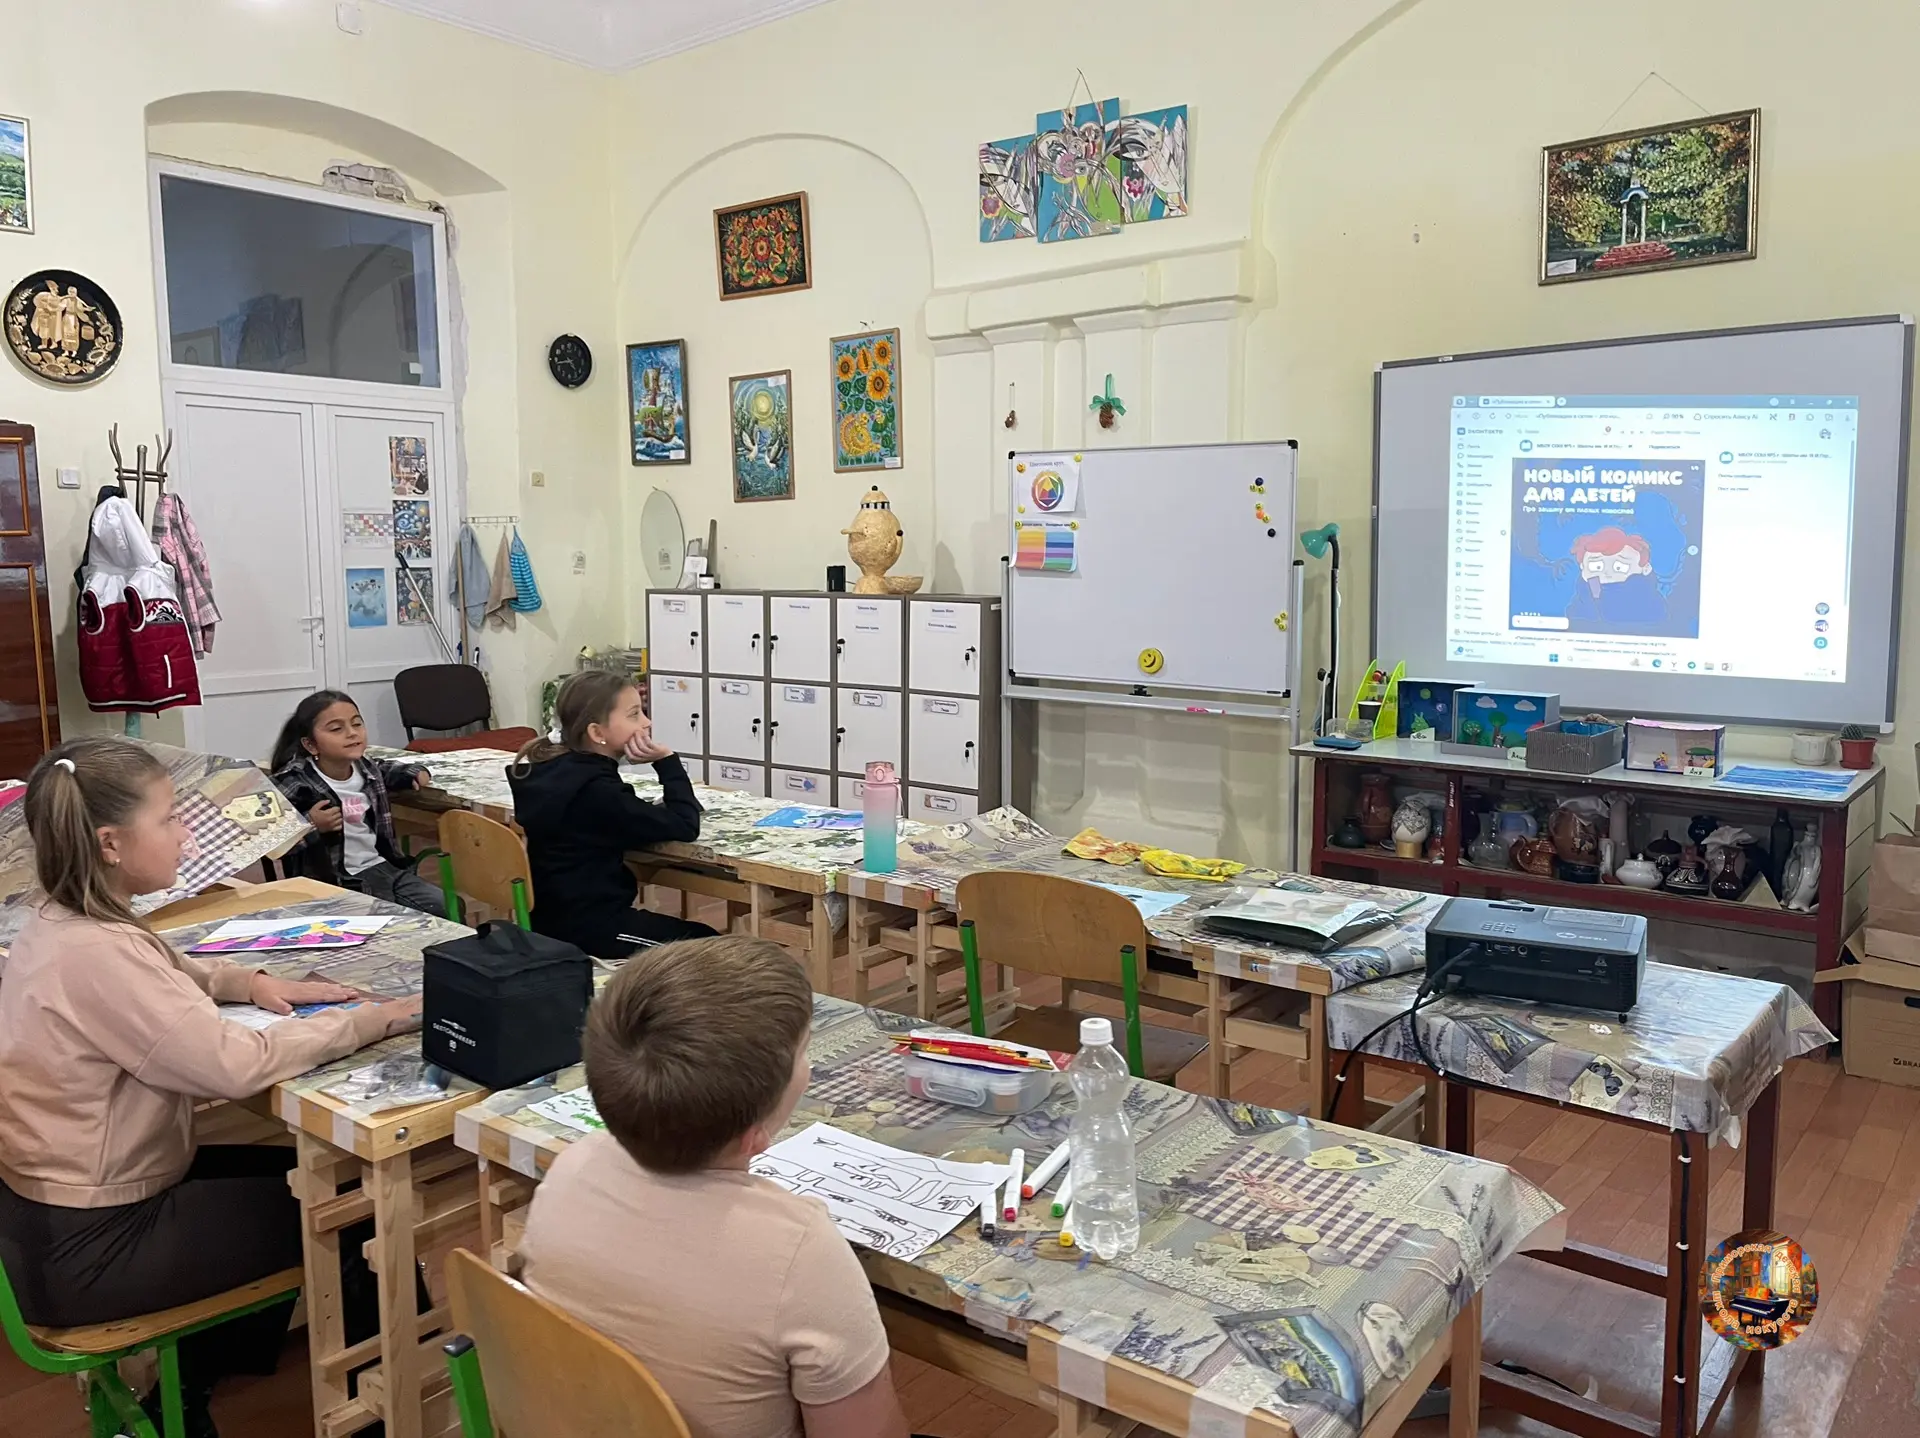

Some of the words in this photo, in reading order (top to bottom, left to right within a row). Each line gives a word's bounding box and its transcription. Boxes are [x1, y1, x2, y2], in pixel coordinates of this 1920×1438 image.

[1523, 465, 1595, 484] НОВЫЙ
[1601, 469, 1683, 486] КОМИКС
[1523, 487, 1565, 503] ДЛЯ
[1569, 484, 1636, 504] ДЕТЕЙ
[1522, 505, 1537, 513] Про
